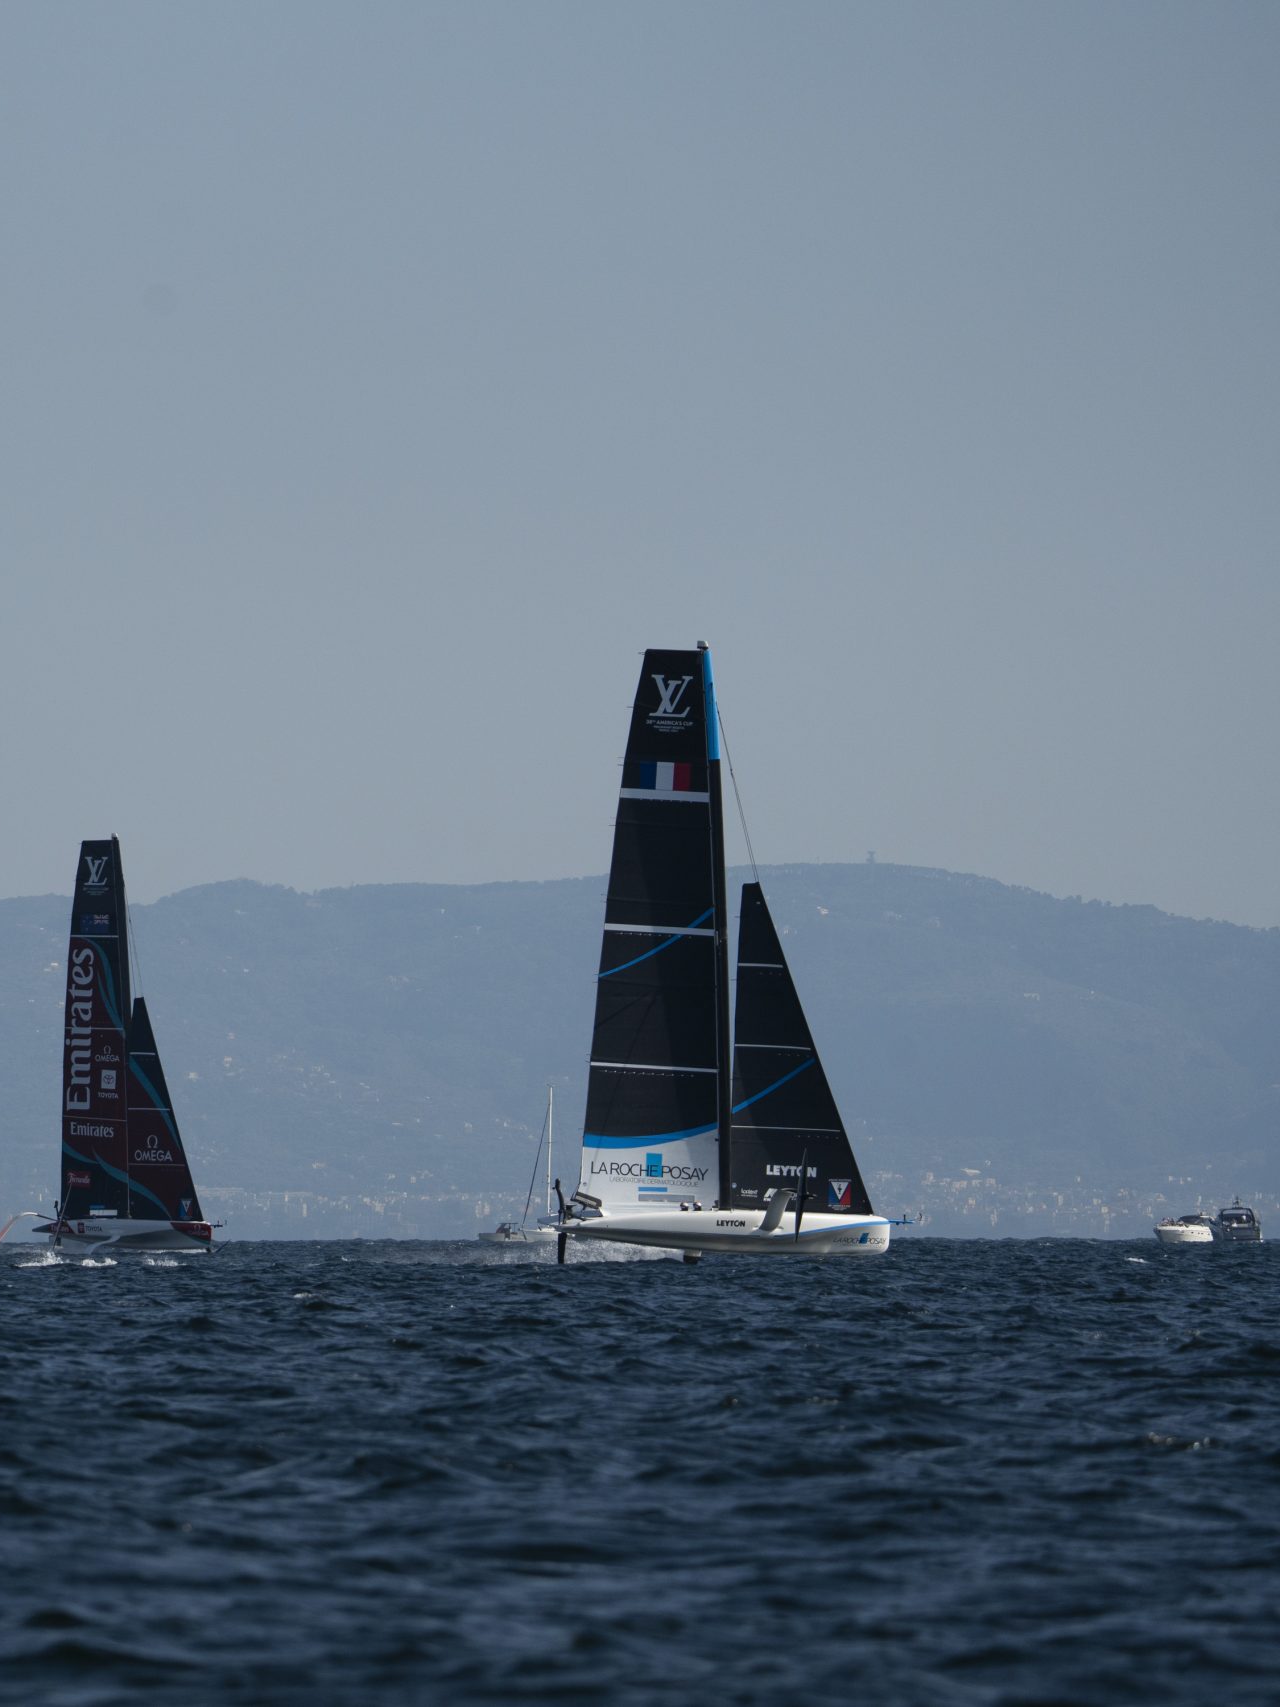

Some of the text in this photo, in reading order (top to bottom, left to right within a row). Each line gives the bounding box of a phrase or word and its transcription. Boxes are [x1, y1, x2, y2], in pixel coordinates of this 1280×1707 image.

[65, 948, 95, 1112] Emirates
[95, 1054, 120, 1063] OMEGA
[97, 1092, 119, 1100] TOYOTA
[70, 1122, 114, 1138] Emirates
[134, 1150, 173, 1162] OMEGA
[591, 1161, 709, 1181] LA ROCHE POSAY
[716, 1219, 746, 1227] LEYTON
[85, 1225, 103, 1233] TOYOTA
